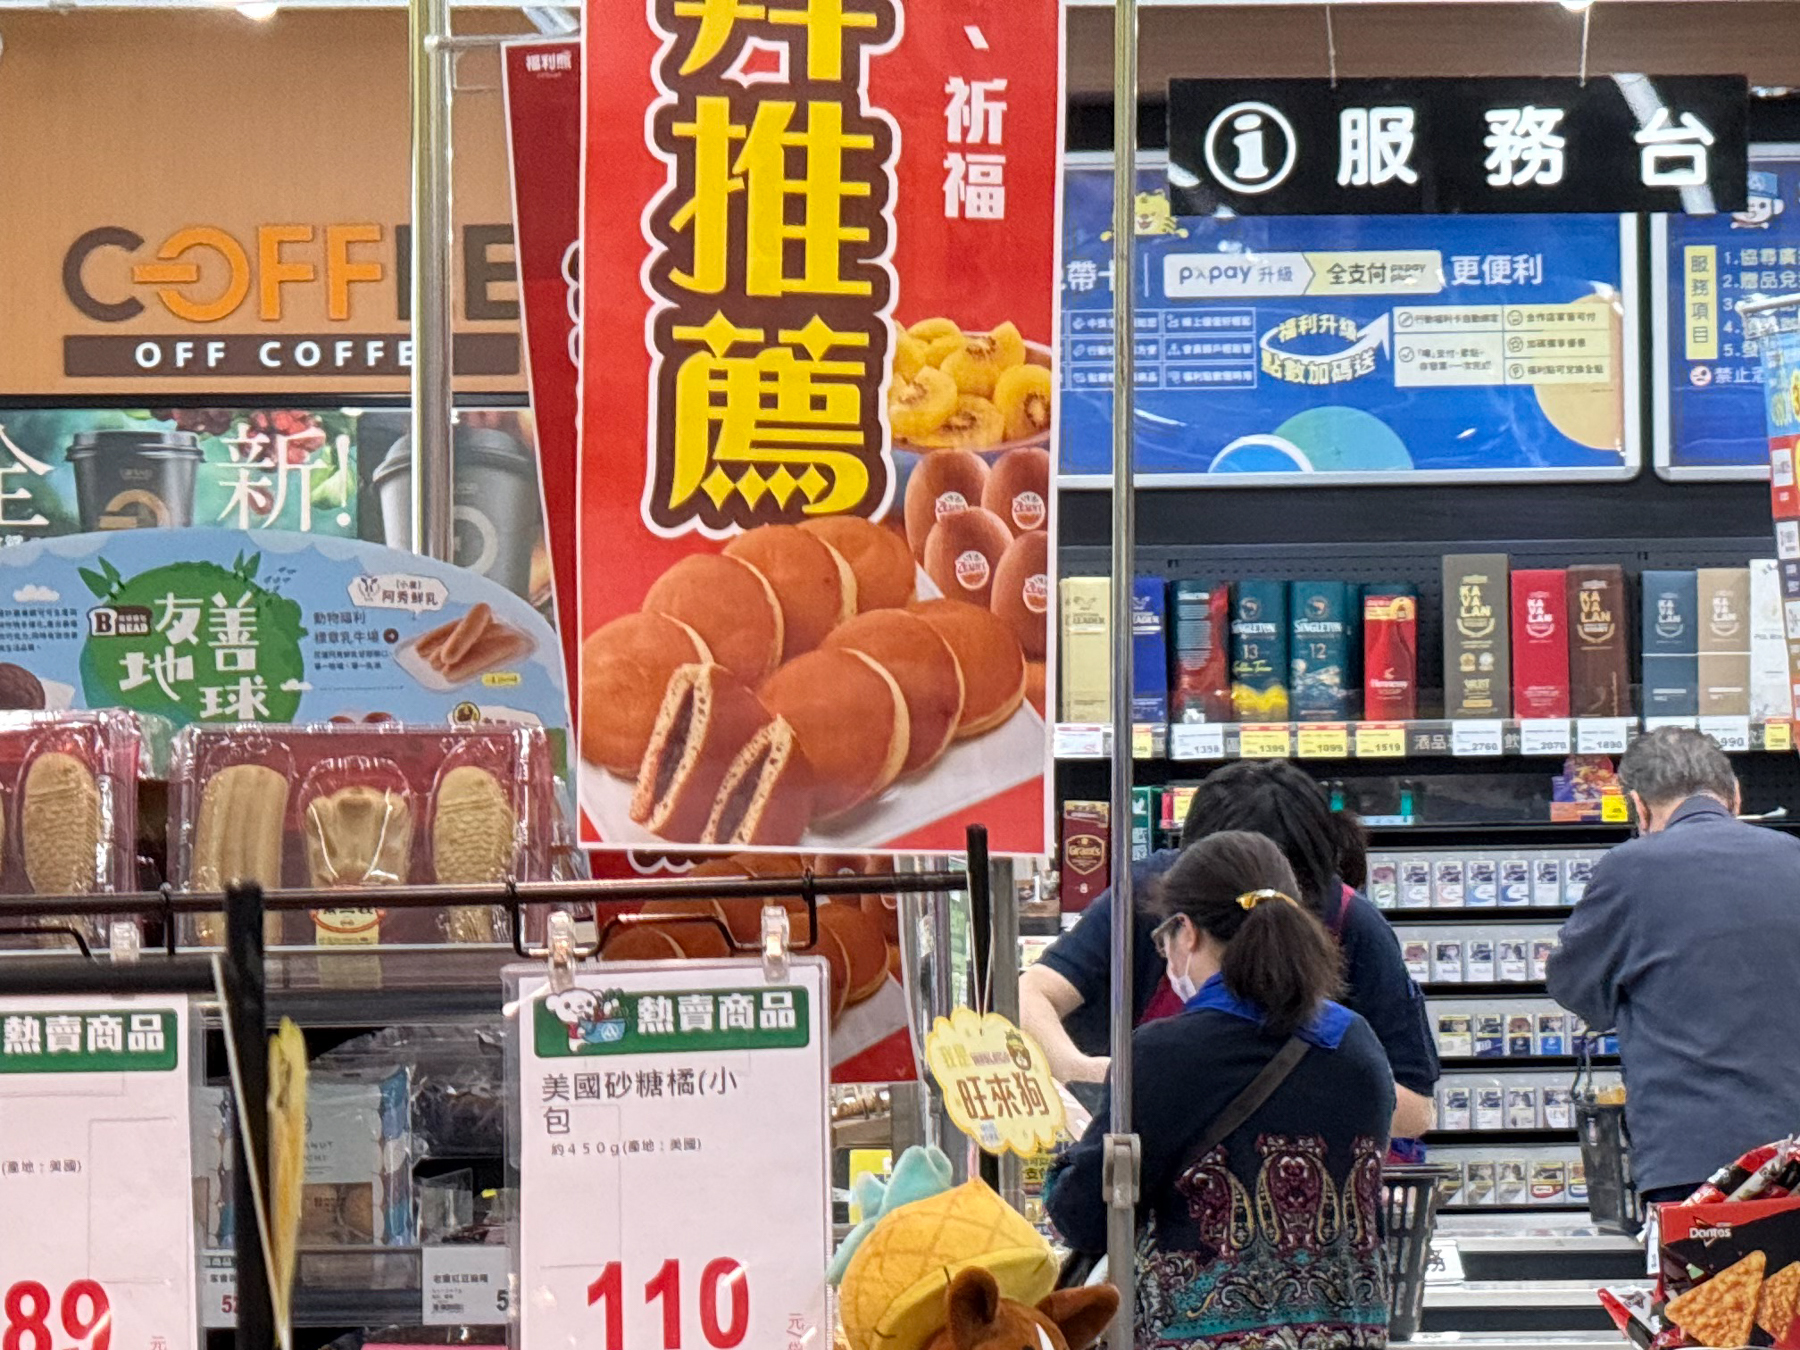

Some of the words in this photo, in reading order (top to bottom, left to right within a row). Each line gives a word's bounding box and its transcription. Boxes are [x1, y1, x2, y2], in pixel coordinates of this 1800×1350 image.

[1337, 106, 1714, 187] 服務台
[62, 226, 520, 322] COFFE
[1326, 263, 1387, 287] 全支付
[1452, 254, 1543, 287] 更便利
[134, 341, 228, 368] OFF
[637, 991, 796, 1034] 熱賣商品
[2, 1013, 165, 1054] 熱賣商品
[543, 1107, 570, 1136] 包
